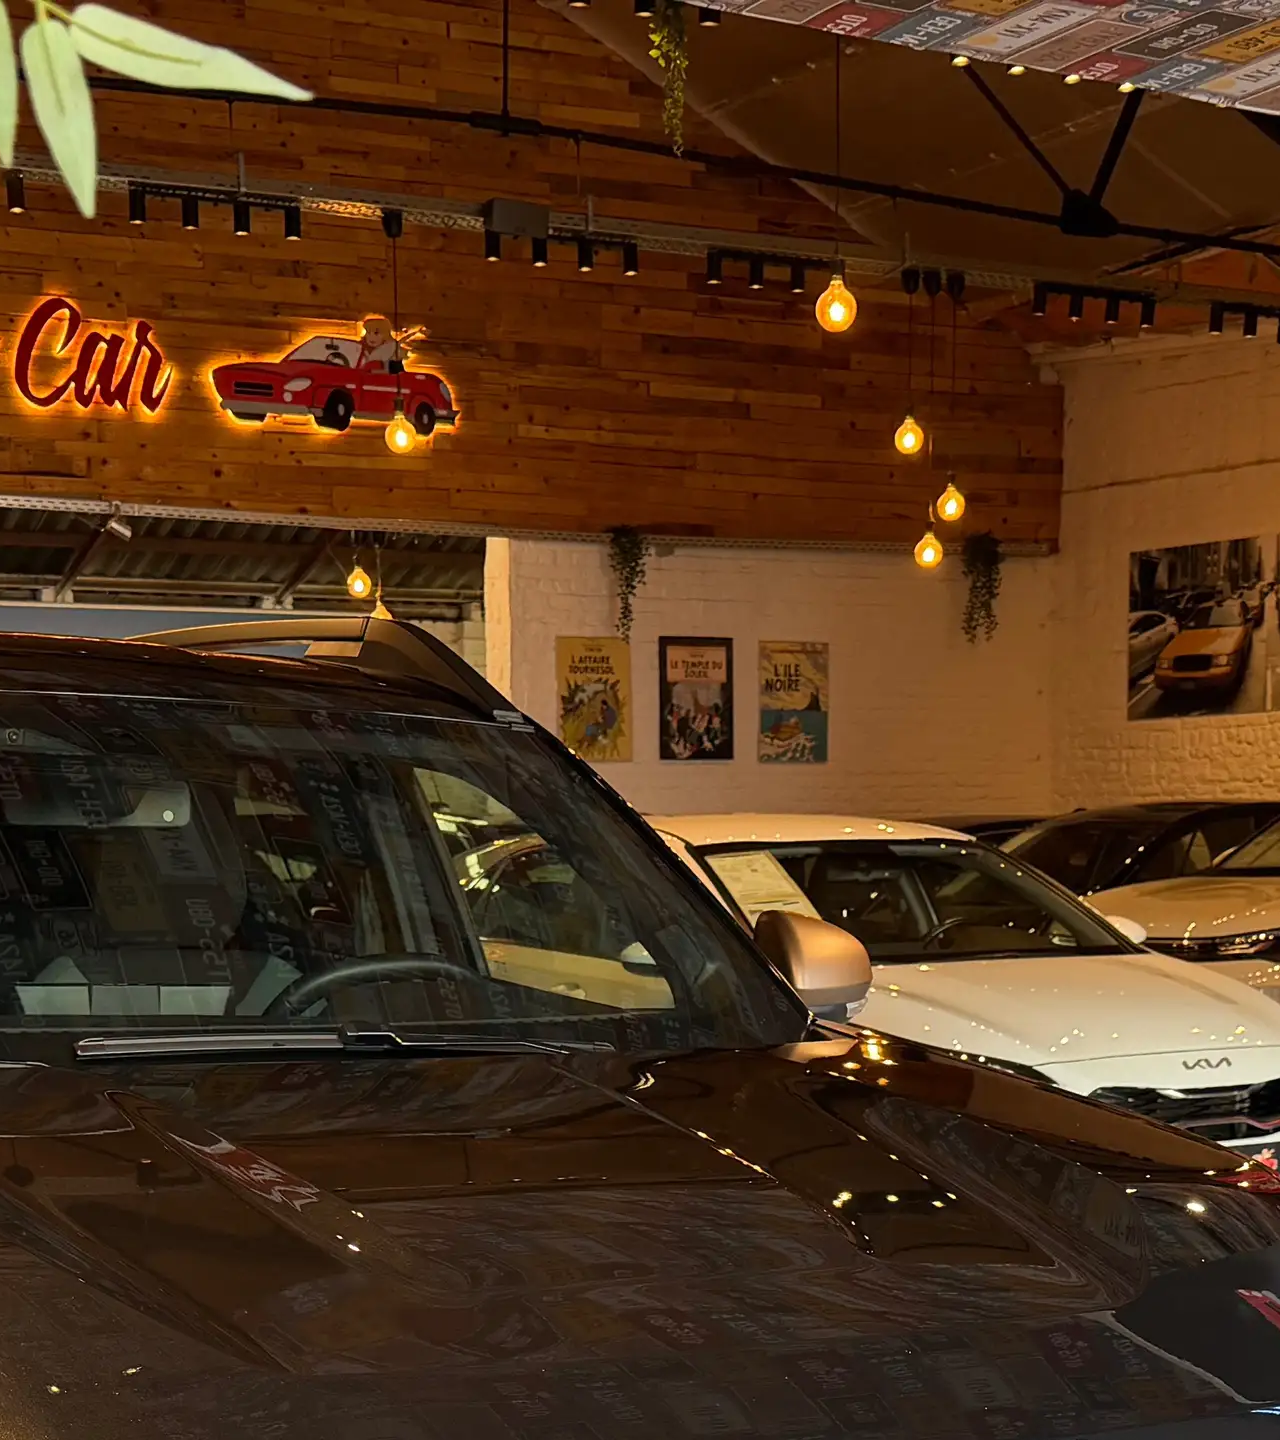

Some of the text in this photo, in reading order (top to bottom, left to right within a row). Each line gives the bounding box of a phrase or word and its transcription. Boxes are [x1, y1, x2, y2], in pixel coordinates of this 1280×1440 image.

[14, 298, 173, 413] Car
[764, 678, 801, 693] NOIRE
[1181, 1057, 1232, 1071] KIA
